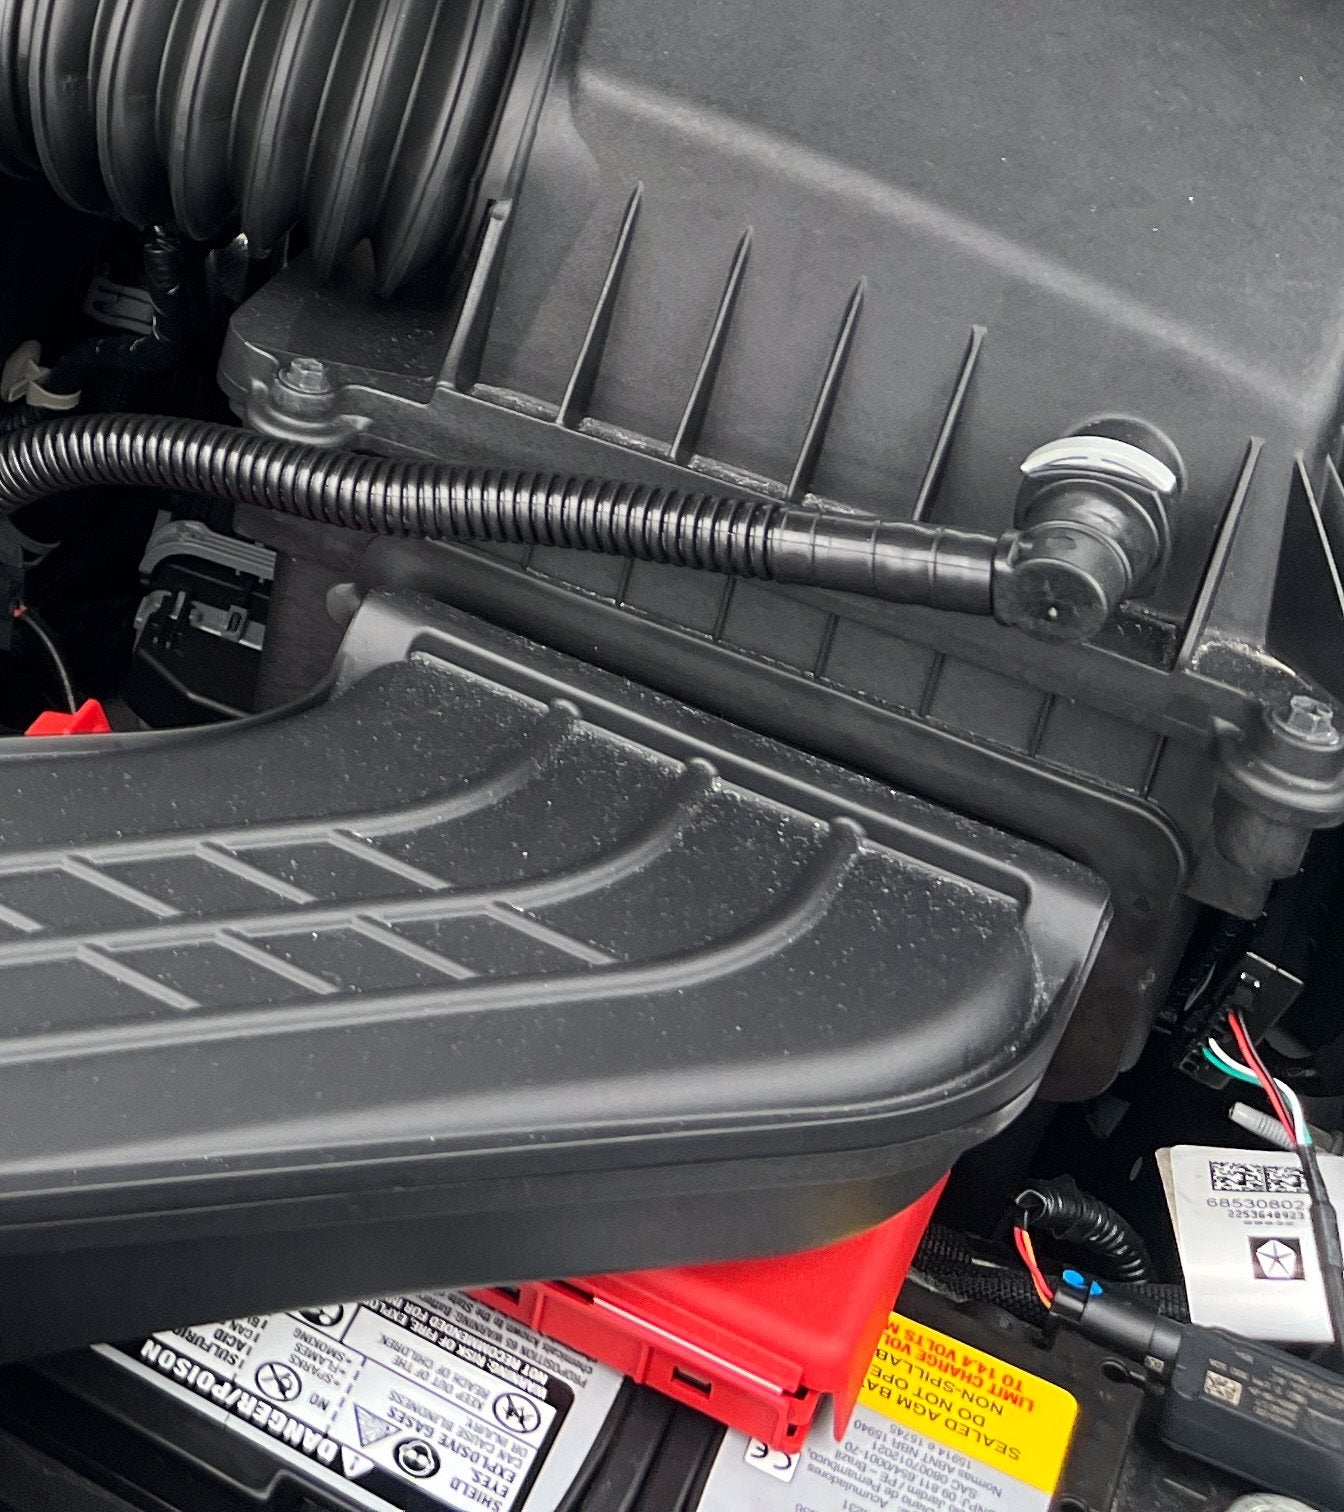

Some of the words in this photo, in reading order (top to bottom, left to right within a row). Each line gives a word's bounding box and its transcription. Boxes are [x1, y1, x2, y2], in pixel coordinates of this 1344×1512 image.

[403, 1301, 429, 1323] FOR
[213, 1328, 247, 1352] ACID
[292, 1327, 346, 1362] SMOKING
[437, 1335, 457, 1352] OF
[904, 1329, 957, 1363] VOLTS
[293, 1342, 339, 1374] FLAMES
[391, 1355, 413, 1374] THE
[916, 1349, 985, 1389] CHARGE
[961, 1355, 996, 1380] 14.4
[413, 1368, 431, 1382] OF
[870, 1363, 909, 1391] OPE
[874, 1348, 1004, 1417] NON-SPILLAB
[1001, 1374, 1023, 1393] TO
[140, 1339, 343, 1464] DANGER/POISON
[309, 1394, 329, 1412] NO
[896, 1393, 941, 1422] AGM
[911, 1386, 954, 1413] NOT
[987, 1383, 1034, 1413] LIMIT
[386, 1406, 435, 1439] GASES
[853, 1418, 888, 1443] 15940
[957, 1407, 986, 1428] DO
[455, 1425, 496, 1455] CAUSE
[889, 1423, 924, 1448] 15745
[891, 1437, 920, 1459] NBR
[944, 1417, 1022, 1461] SEALED
[437, 1432, 517, 1484] EXPLOSIVE
[801, 1446, 885, 1494] Pernambuco,
[834, 1448, 868, 1474] Brazil
[871, 1440, 950, 1486] 08007012021
[921, 1452, 956, 1475] ABNT
[937, 1446, 972, 1470] 15914
[806, 1462, 891, 1510] Acumuladores
[879, 1471, 898, 1488] PE
[883, 1486, 900, 1500] de
[949, 1478, 979, 1500] SAC
[957, 1468, 1003, 1499] Normas
[906, 1483, 947, 1510] Jardim
